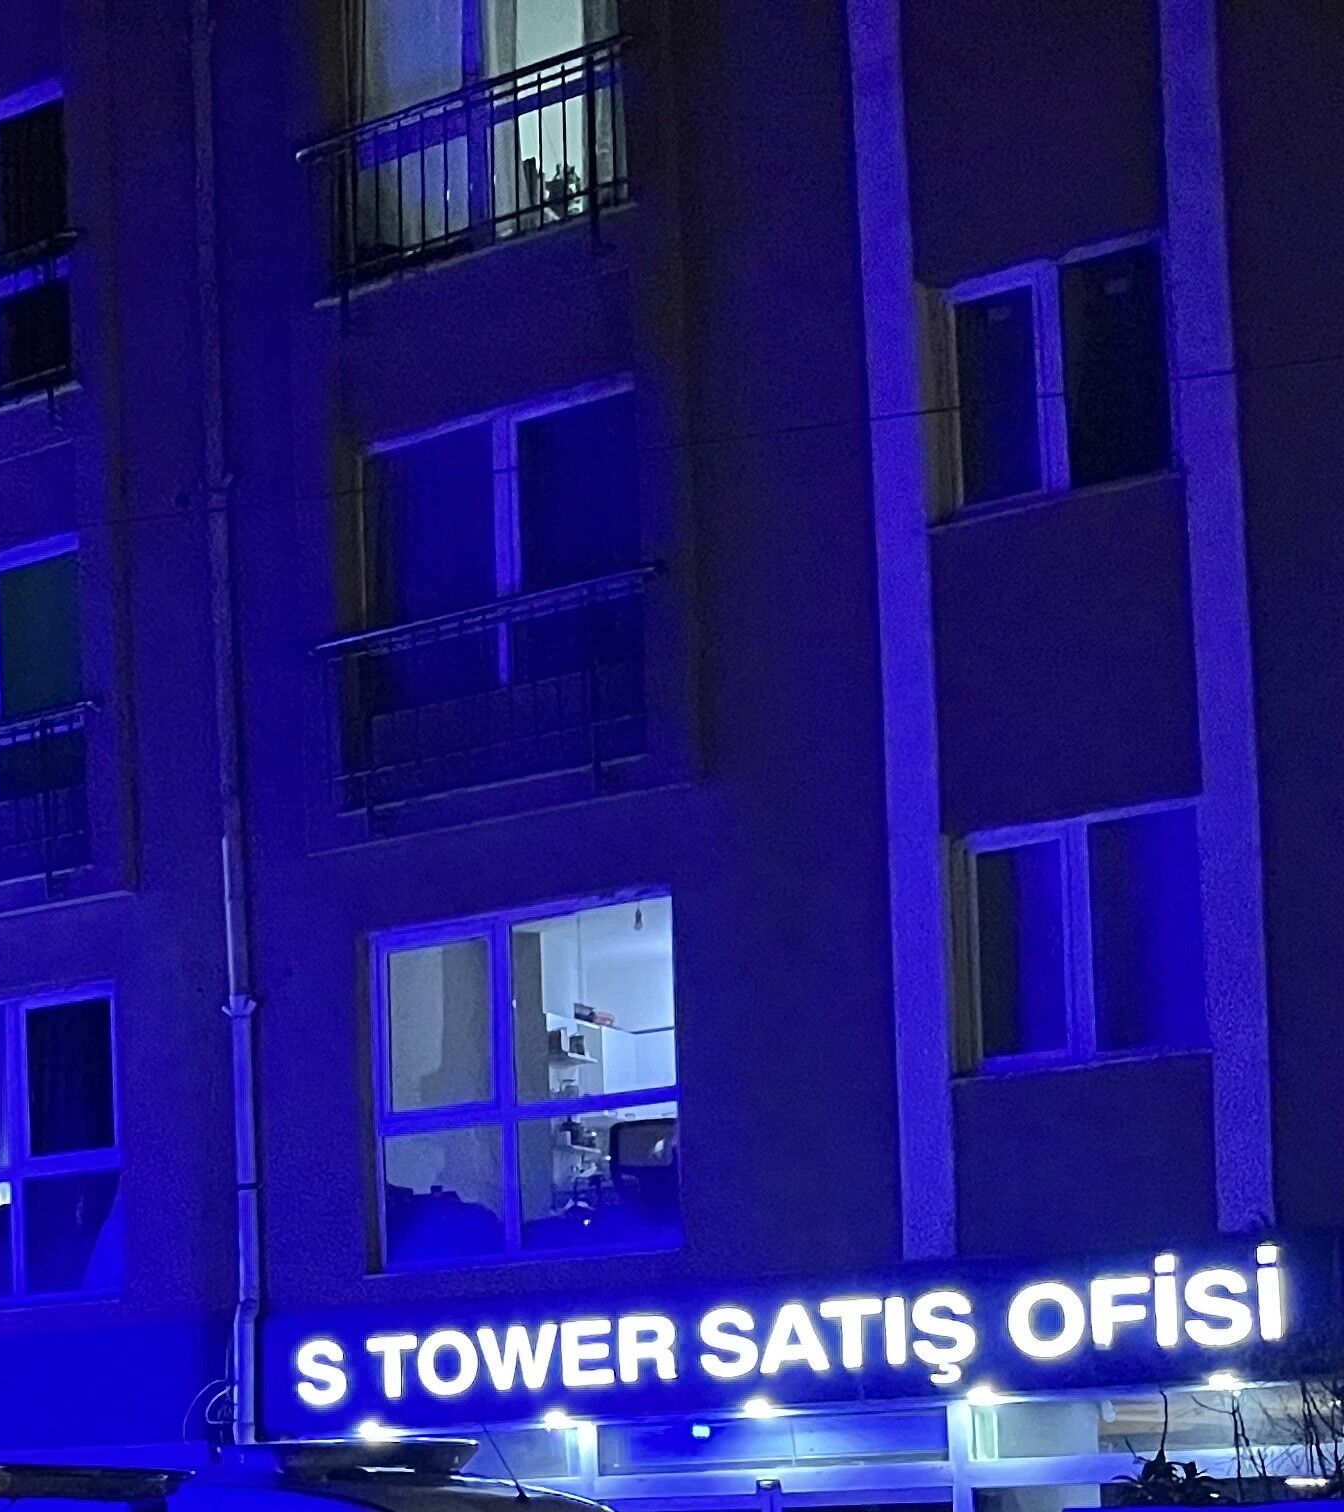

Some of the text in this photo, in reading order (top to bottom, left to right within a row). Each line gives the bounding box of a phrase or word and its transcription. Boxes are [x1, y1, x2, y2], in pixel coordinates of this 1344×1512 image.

[295, 1244, 1288, 1408] S TOWER SATIŞ OFİSİ
